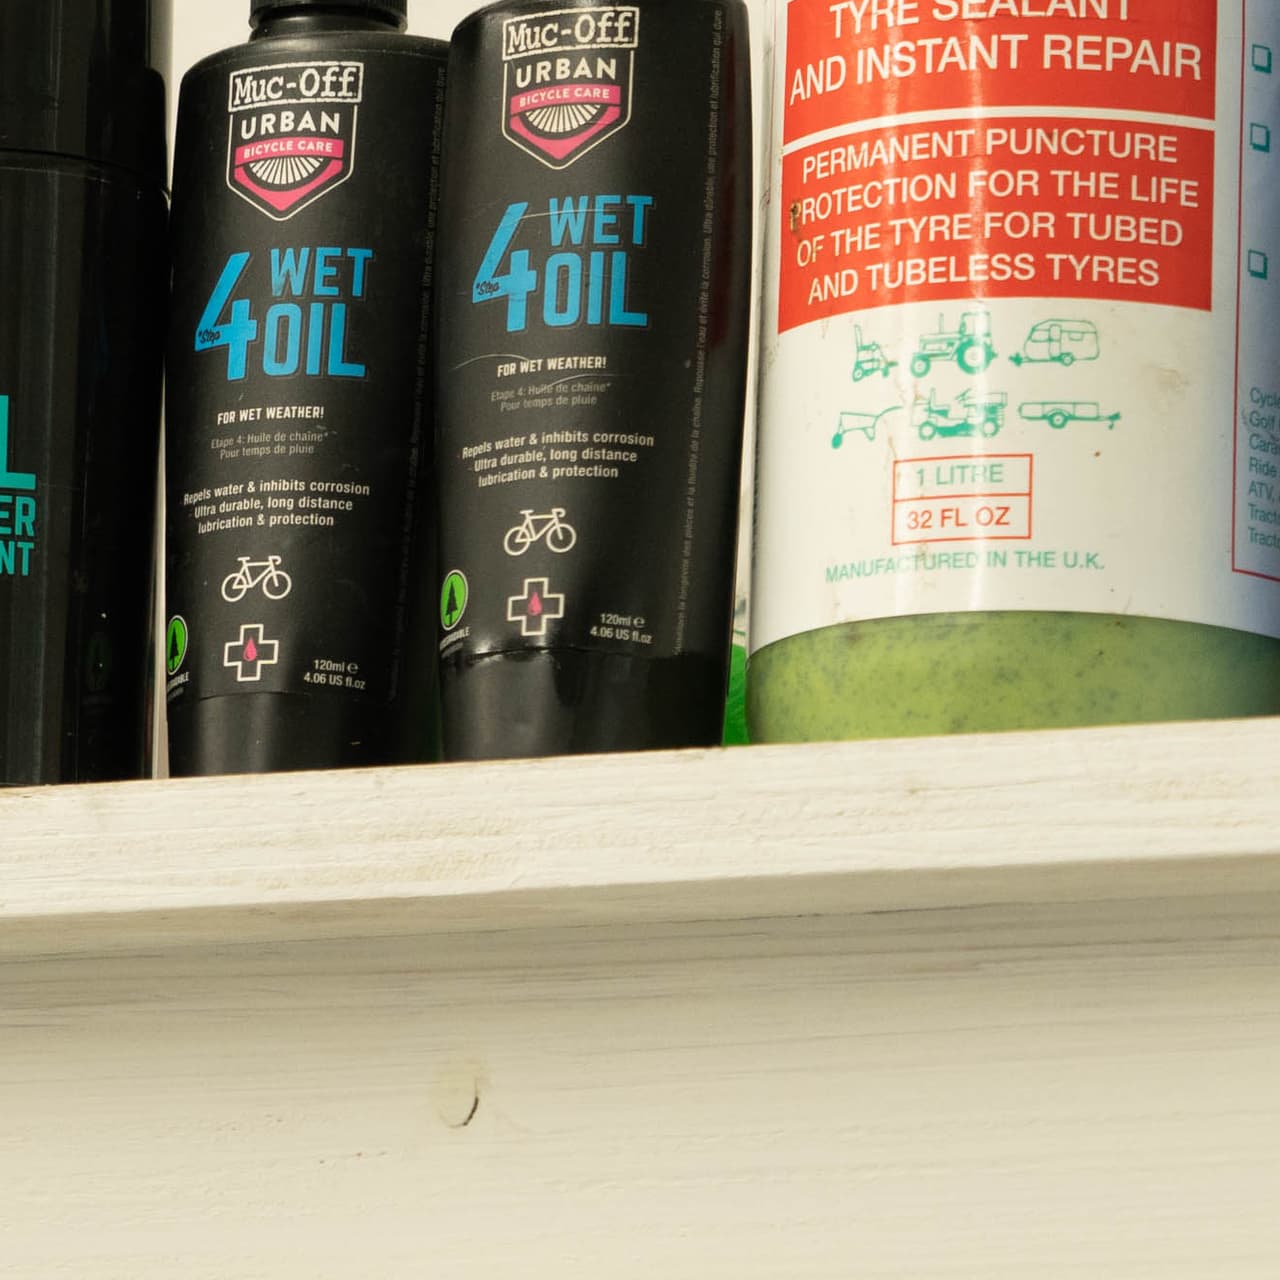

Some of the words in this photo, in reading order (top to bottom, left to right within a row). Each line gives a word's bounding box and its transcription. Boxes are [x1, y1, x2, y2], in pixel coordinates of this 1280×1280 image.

[507, 11, 634, 54] Muc-Off
[516, 57, 617, 88] URBAN
[789, 55, 846, 106] AND
[856, 33, 1029, 84] INSTANT
[1042, 35, 1202, 81] REPAIR
[233, 67, 359, 106] Muc-Off
[519, 88, 571, 108] BICYCLE
[573, 87, 610, 100] CARE
[240, 110, 341, 139] URBAN
[243, 141, 295, 159] BICYCLE
[298, 140, 333, 153] CARE
[802, 128, 976, 185] PERMANENT
[985, 128, 1178, 163] PUNCTURE
[789, 172, 957, 230] PROTECTION
[968, 169, 1039, 199] FOR
[1050, 170, 1119, 200] THE
[1130, 175, 1199, 208] LIFE
[796, 235, 824, 268] OF
[830, 222, 881, 257] THE
[889, 213, 974, 247] TYRE
[982, 211, 1056, 241] FOR
[1066, 213, 1184, 248] TUBED
[473, 202, 537, 332] 4
[549, 195, 653, 246] WET
[543, 251, 648, 327] OIL
[807, 268, 858, 306] AND
[865, 253, 1036, 290] TUBELESS
[1046, 254, 1160, 287] TYRES
[195, 252, 257, 381] 4
[270, 246, 373, 297] WET
[263, 302, 367, 378] OIL
[497, 363, 517, 378] FOR
[520, 358, 544, 374] WET
[547, 356, 607, 370] WEATHER!
[217, 410, 235, 425] FOR
[239, 408, 262, 421] WET
[266, 406, 324, 420] WEATHER!
[461, 440, 492, 460] Repels
[495, 435, 526, 451] water
[528, 433, 538, 446] &
[541, 431, 589, 445] inhibits
[593, 432, 655, 447] corrosion
[474, 454, 497, 472] Ultra
[500, 449, 547, 466] durable,
[550, 448, 577, 463] long
[581, 447, 638, 462] distance
[478, 466, 535, 488] lubrication
[538, 465, 549, 478] &
[552, 465, 619, 480] protection
[915, 467, 926, 487] 1
[934, 463, 1004, 486] LITRE
[183, 488, 211, 506] Repels
[214, 482, 244, 498] water
[247, 481, 256, 493] &
[259, 479, 305, 492] inhibits
[309, 480, 370, 496] corrosion
[194, 503, 216, 519] Ultra
[219, 498, 264, 513] durable,
[267, 496, 295, 511] long
[298, 496, 353, 511] distance
[198, 515, 253, 534] lubrication
[256, 514, 265, 526] &
[269, 513, 335, 528] protection
[906, 508, 933, 530] 32
[940, 506, 968, 529] FL
[975, 505, 1011, 528] OZ
[825, 550, 978, 584] MANUFACTURED
[986, 551, 1005, 569] IN
[1015, 550, 1053, 569] THE
[1062, 551, 1105, 571] U.K.
